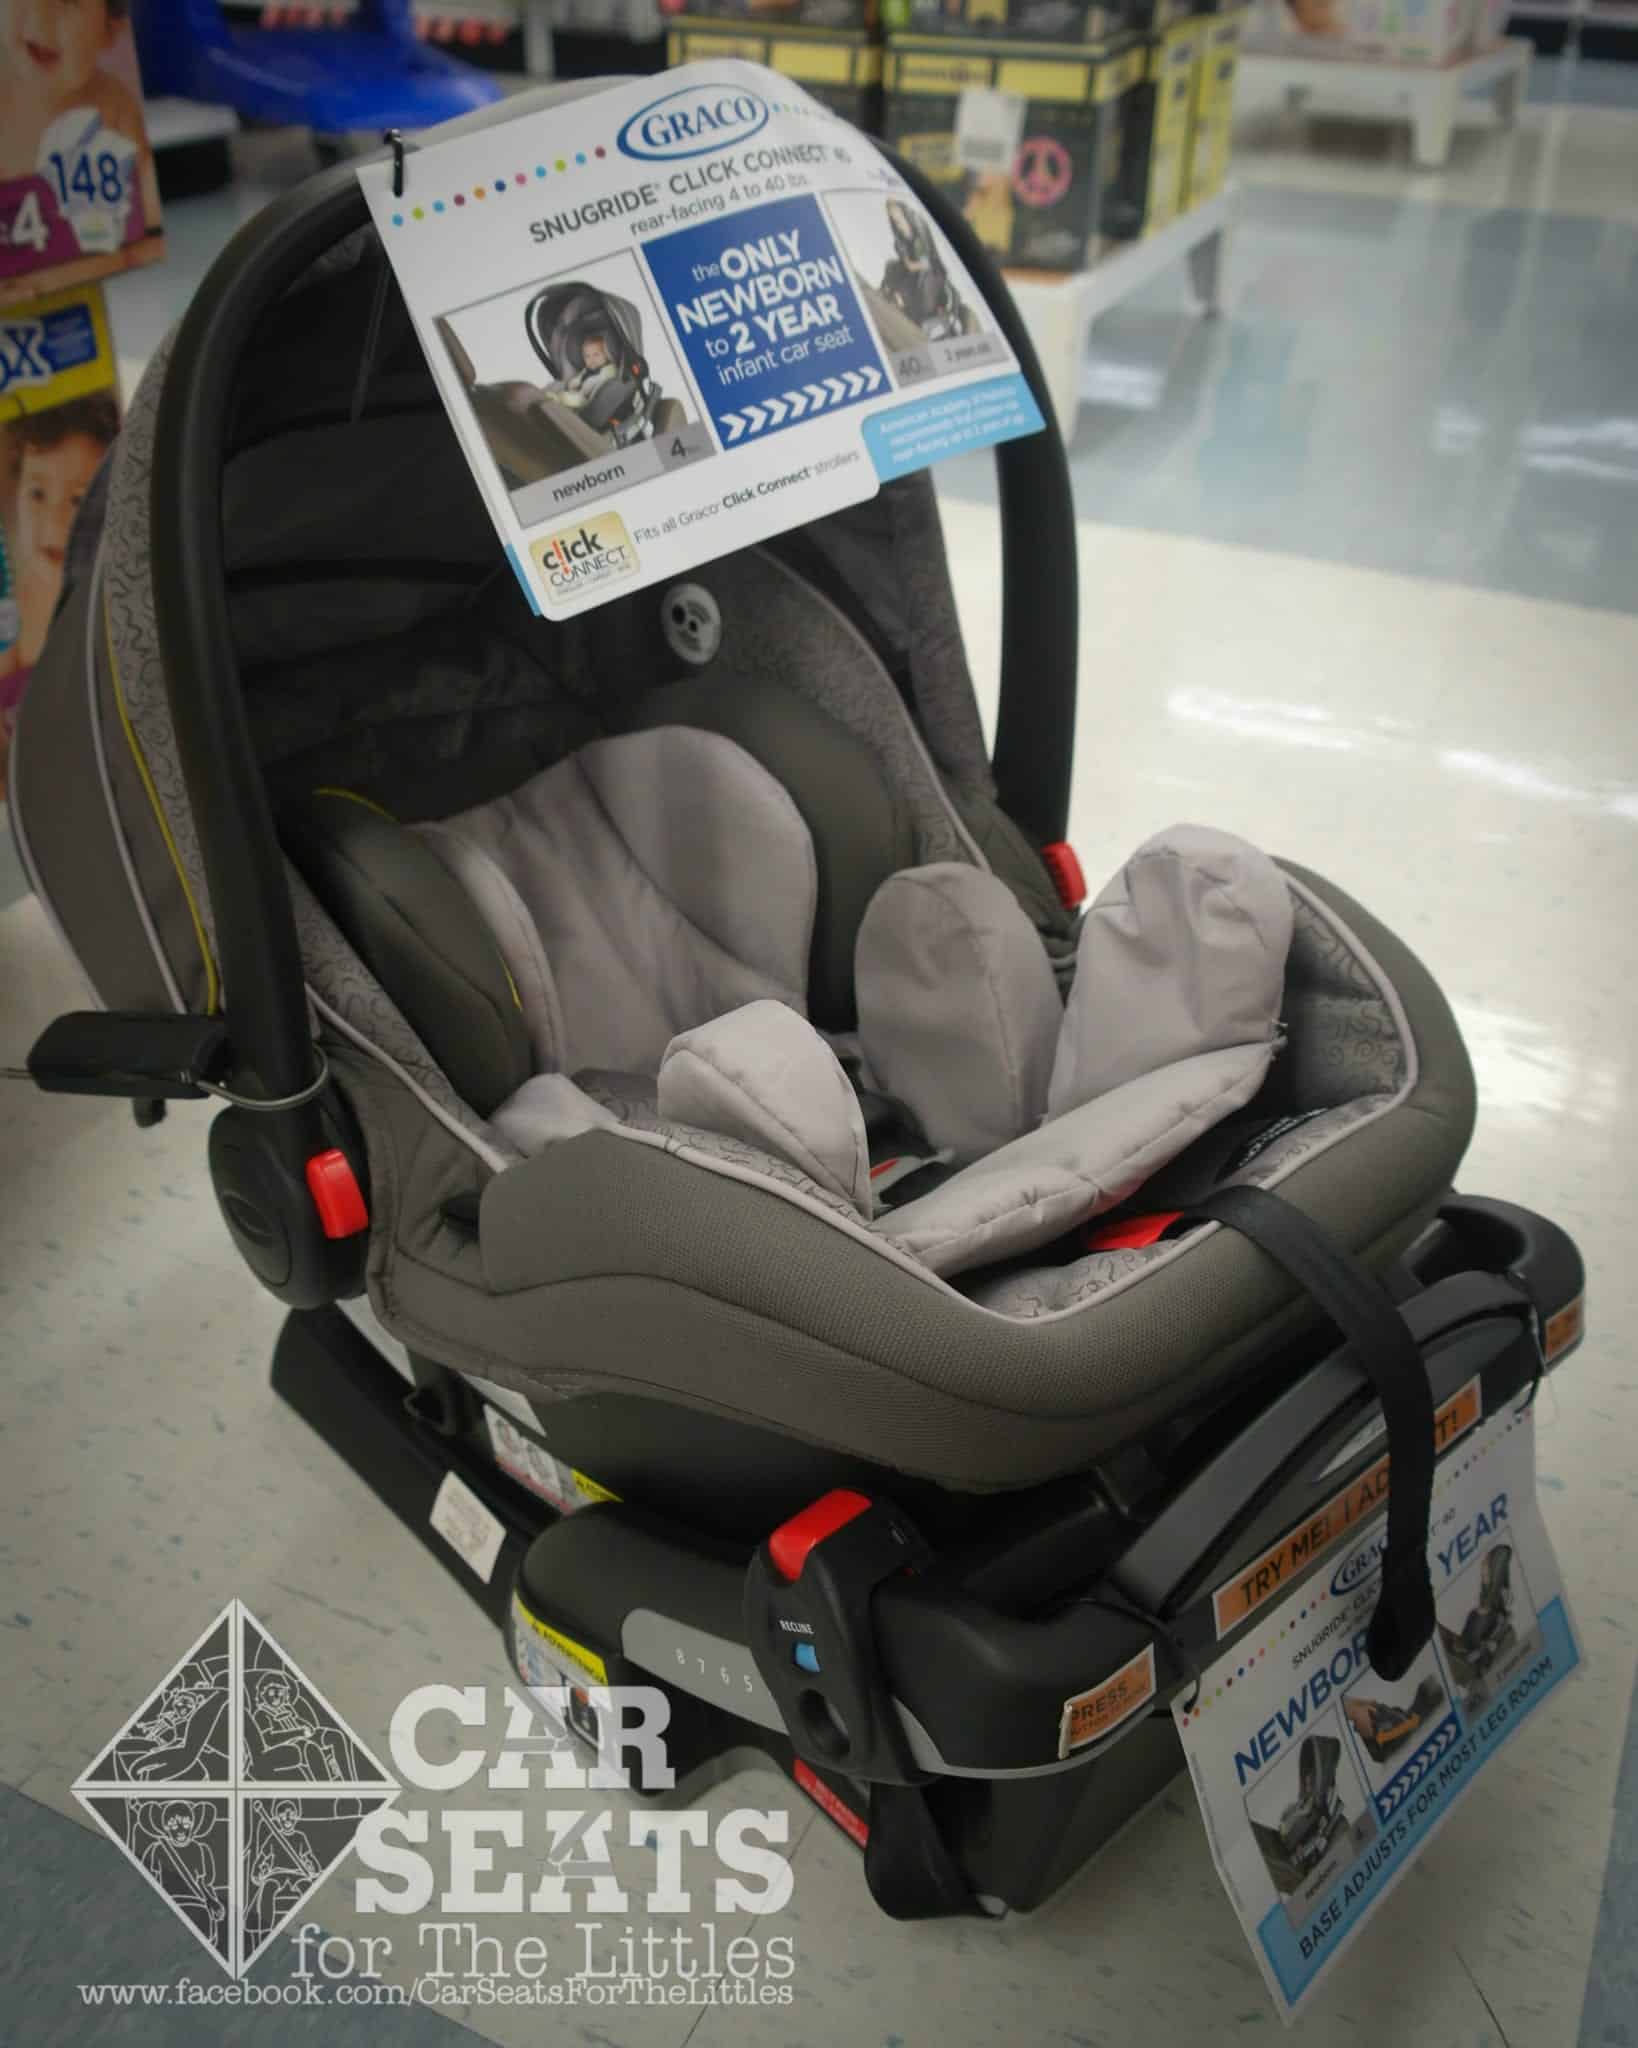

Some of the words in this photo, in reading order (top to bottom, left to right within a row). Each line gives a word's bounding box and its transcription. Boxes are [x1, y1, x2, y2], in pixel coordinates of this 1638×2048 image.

[641, 95, 758, 147] GRACO
[50, 152, 123, 204] 148
[669, 156, 738, 195] CLICK
[743, 144, 824, 174] CONNECT
[630, 192, 726, 235] rear-facing
[729, 186, 740, 202] 4
[743, 183, 761, 200] to
[765, 174, 786, 191] 40
[692, 260, 721, 283] the
[720, 229, 800, 280] ONLY
[676, 255, 844, 334] NEWBORN
[705, 336, 730, 358] to
[729, 322, 755, 354] 2
[752, 293, 844, 343] YEAR
[0, 326, 44, 392] X
[716, 352, 780, 385] infant
[781, 341, 811, 364] car
[815, 325, 855, 352] seat
[552, 463, 626, 502] newborn
[669, 437, 688, 458] 4
[633, 524, 660, 545] Fits
[661, 517, 677, 536] all
[722, 487, 756, 510] Click
[757, 467, 812, 495] Connect
[551, 545, 627, 588] CONNECT
[1239, 1552, 1285, 1609] TRY
[1288, 1517, 1332, 1569] ME!
[779, 1618, 815, 1635] RECLINE
[1233, 1629, 1372, 1786] NEWBOR
[1437, 1491, 1509, 1579] YEAR
[1300, 1904, 1342, 1960] BASE
[1344, 1825, 1406, 1907] ADJUSTS
[1407, 1782, 1438, 1827] FOR
[1438, 1740, 1480, 1787] MOST
[1479, 1706, 1508, 1744] LEG
[1508, 1656, 1554, 1712] ROOM
